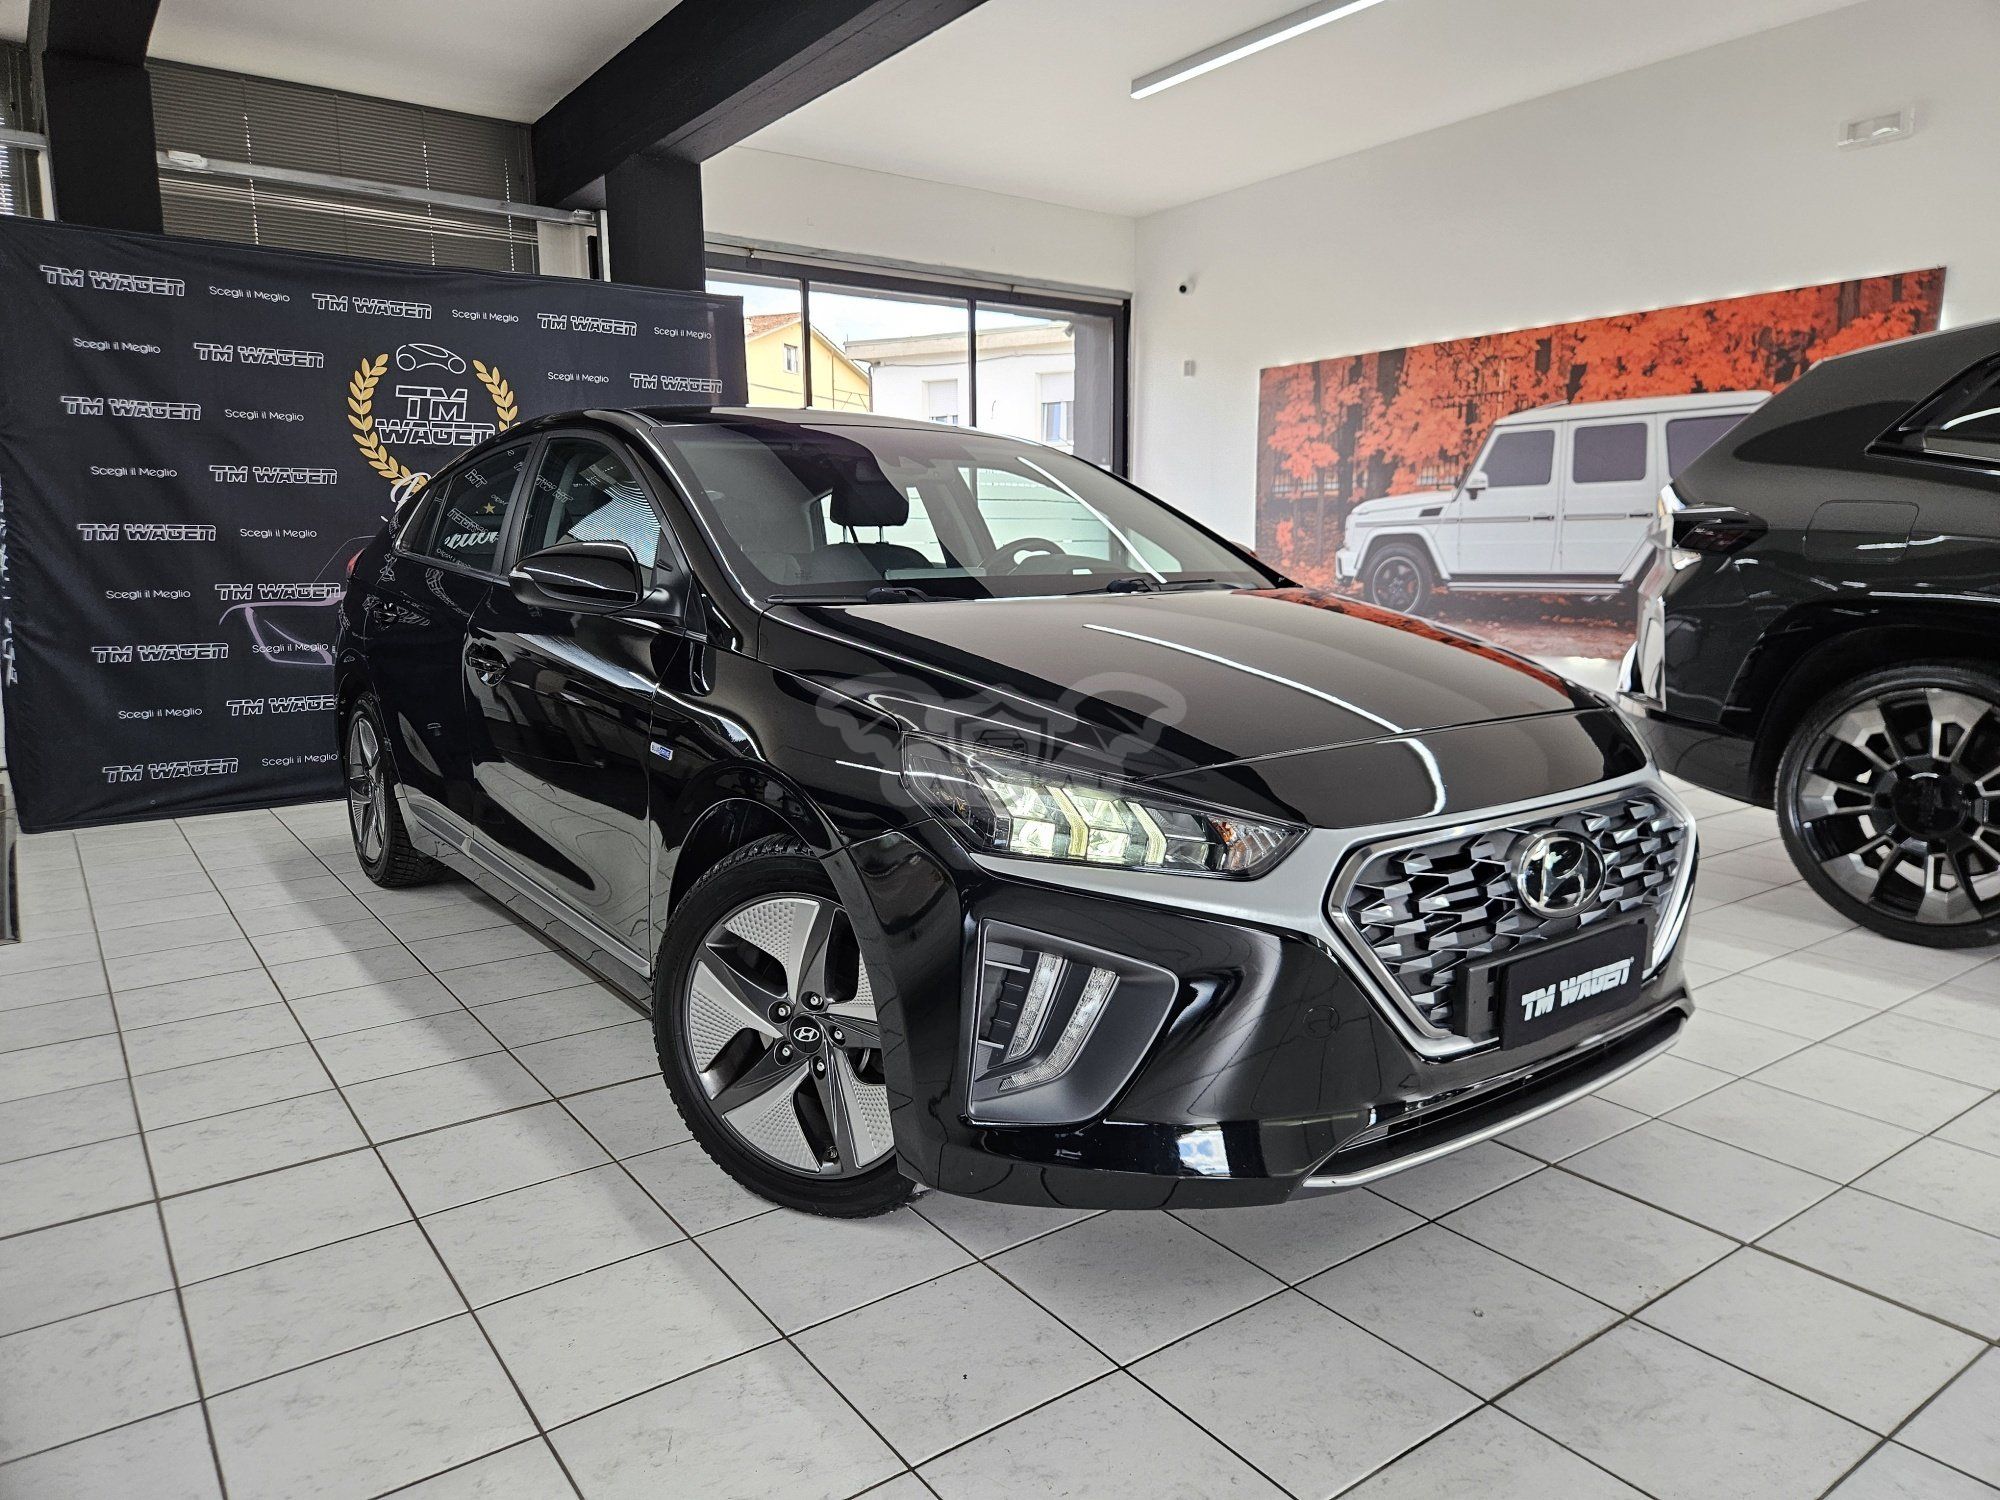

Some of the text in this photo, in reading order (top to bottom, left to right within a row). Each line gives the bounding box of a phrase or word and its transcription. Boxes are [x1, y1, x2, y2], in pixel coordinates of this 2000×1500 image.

[39, 264, 84, 287] TM
[209, 286, 243, 298] Scegli
[254, 291, 290, 302] Meglio
[312, 293, 348, 312] TM
[452, 309, 480, 320] Scegli
[489, 313, 519, 323] Meglio
[537, 313, 567, 330] TM
[654, 327, 678, 337] Scegli
[686, 331, 713, 340] Meglio
[73, 337, 110, 351] Scegli
[121, 342, 161, 354] Meglio
[192, 342, 233, 362] TM
[548, 372, 574, 382] Scegli
[582, 374, 609, 383] Meglio
[629, 373, 658, 389] TM
[60, 396, 104, 415] TM
[396, 385, 468, 421] TM
[225, 409, 258, 420] Scegli
[269, 411, 304, 423] Meglio
[90, 466, 128, 477] Scegli
[138, 468, 177, 478] Meglio
[209, 465, 248, 482] TM
[76, 523, 119, 541] TM
[240, 529, 272, 538] Scegli
[283, 530, 317, 538] Meglio
[105, 590, 142, 600] Scegli
[153, 590, 191, 599] Meglio
[215, 584, 253, 600] TM
[90, 646, 133, 663] TM
[252, 644, 285, 654] Scegli
[296, 642, 329, 652] Meglio
[226, 694, 337, 716] TM WAGE
[118, 710, 154, 719] Scegli
[165, 708, 202, 717] Meglio
[262, 756, 294, 766] Scegli
[305, 752, 338, 763] Meglio
[102, 765, 143, 783] TM
[1521, 983, 1556, 1022] TM
